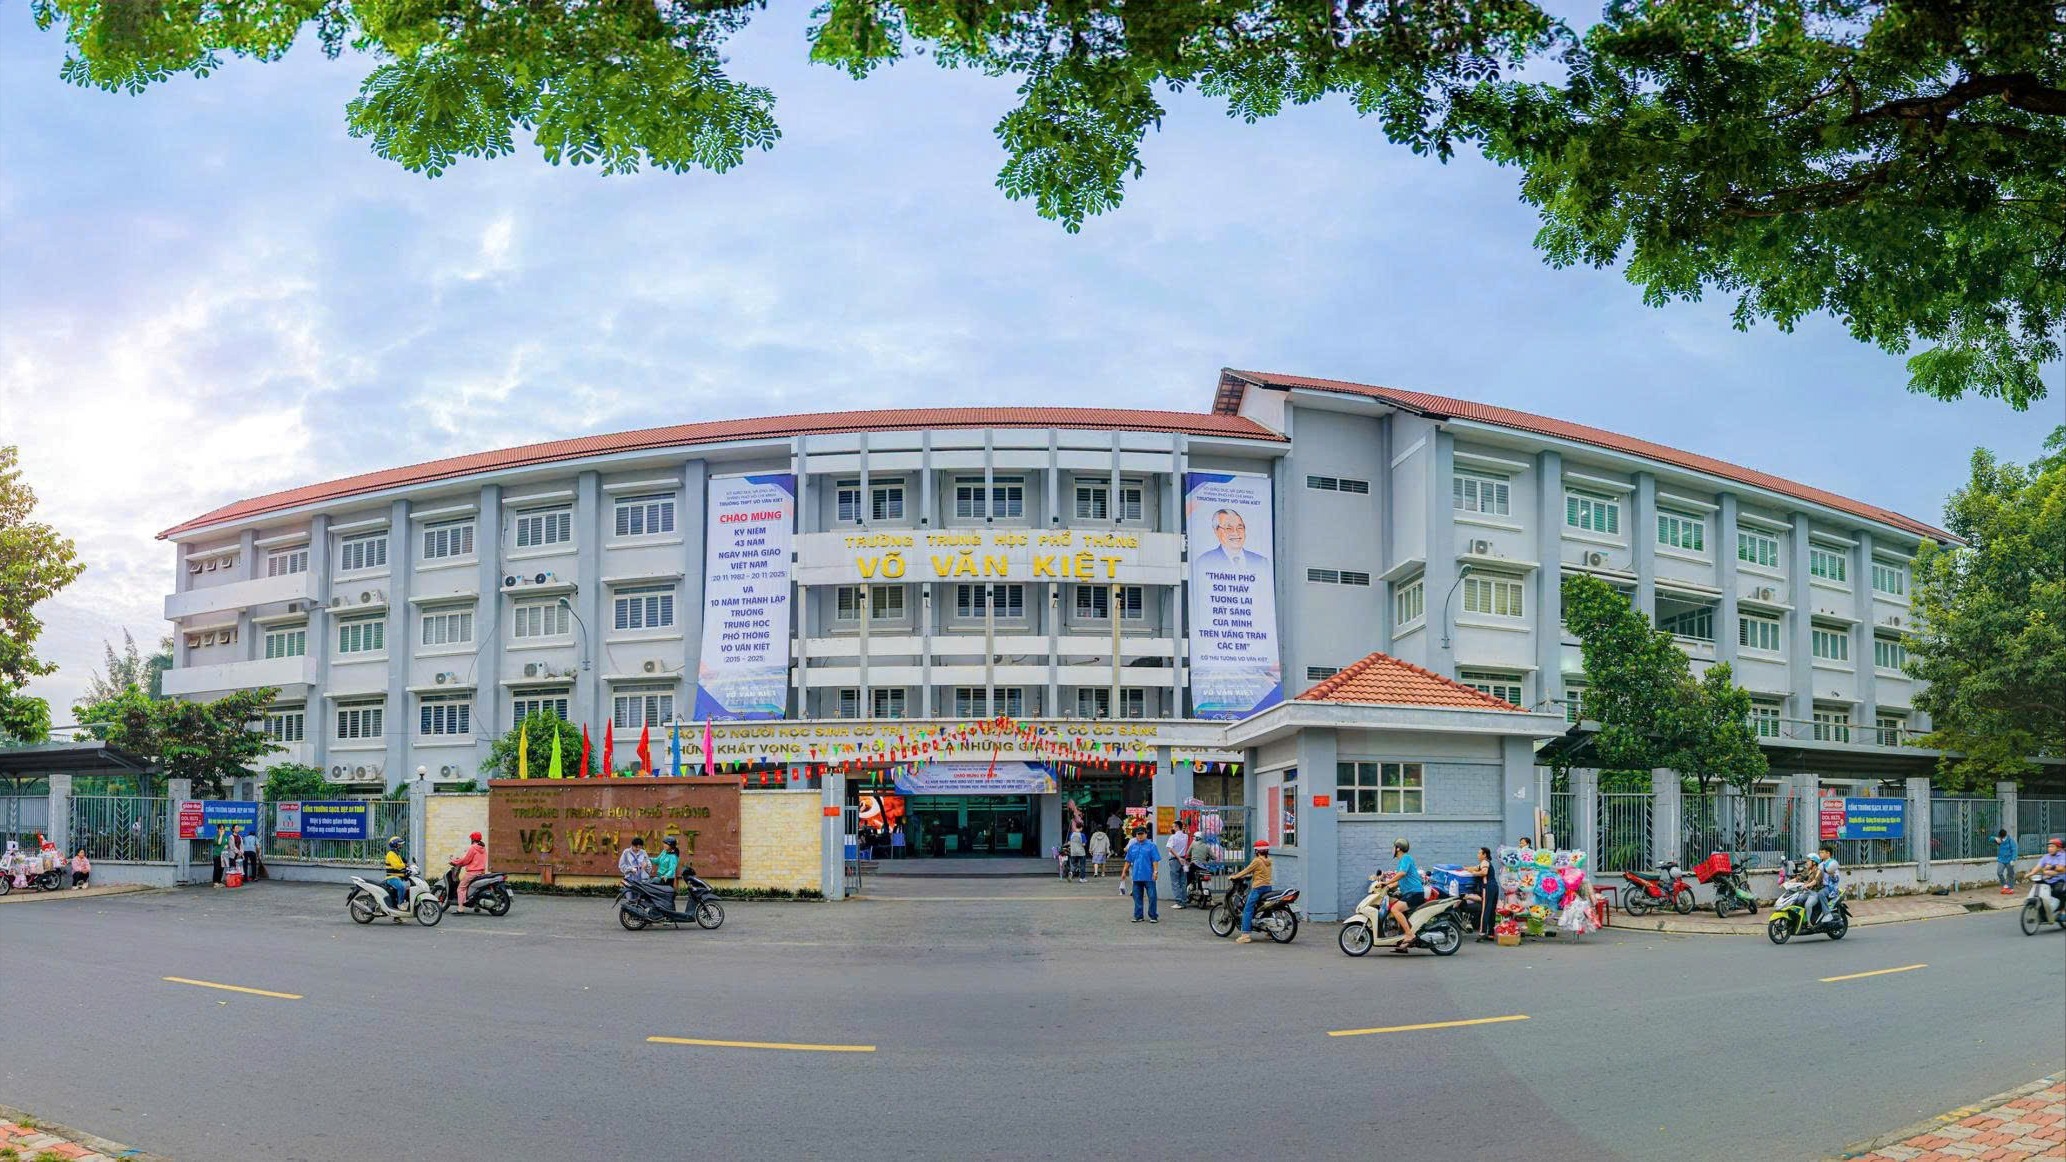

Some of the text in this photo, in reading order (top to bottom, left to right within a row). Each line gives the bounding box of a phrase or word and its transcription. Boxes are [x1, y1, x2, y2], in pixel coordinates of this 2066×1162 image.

[926, 534, 982, 547] TRUNG
[856, 549, 1123, 582] VÕ VĂN KIỆT
[724, 621, 750, 629] TRUNG
[815, 726, 850, 738] SINH
[717, 742, 756, 754] KHÁT
[519, 822, 554, 854] VÕ
